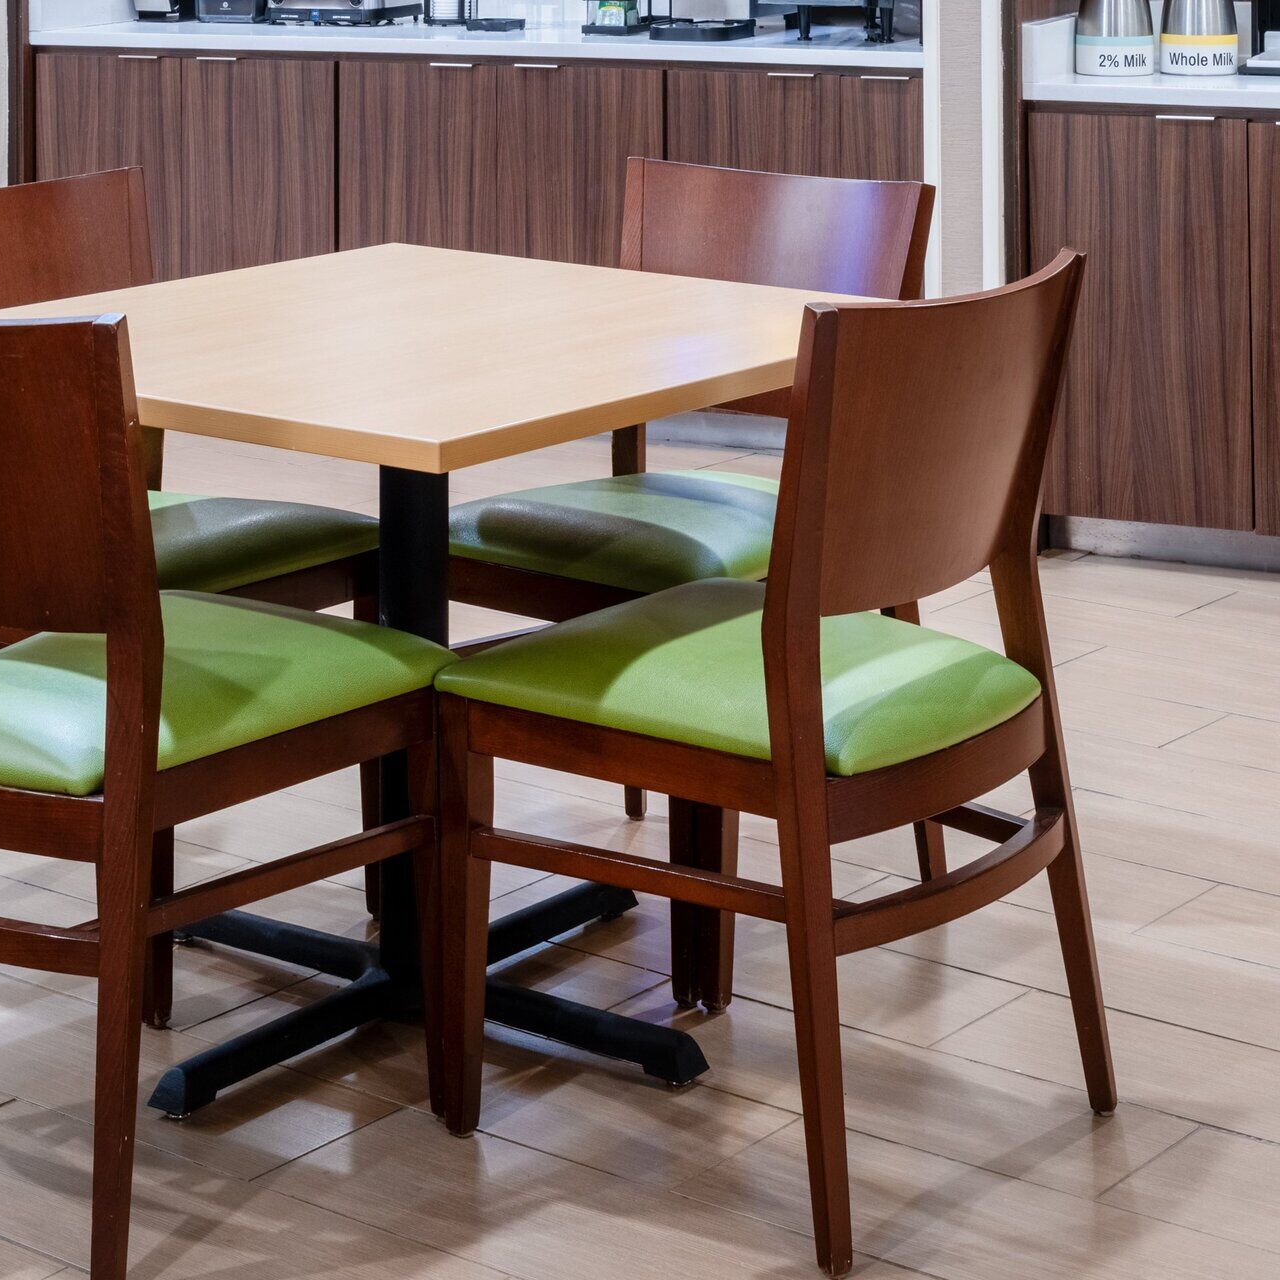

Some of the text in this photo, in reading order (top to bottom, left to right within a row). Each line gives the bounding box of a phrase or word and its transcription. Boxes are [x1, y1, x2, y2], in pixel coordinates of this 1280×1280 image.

[1098, 54, 1147, 68] 2% Milk
[1169, 52, 1234, 67] Whole Milk
